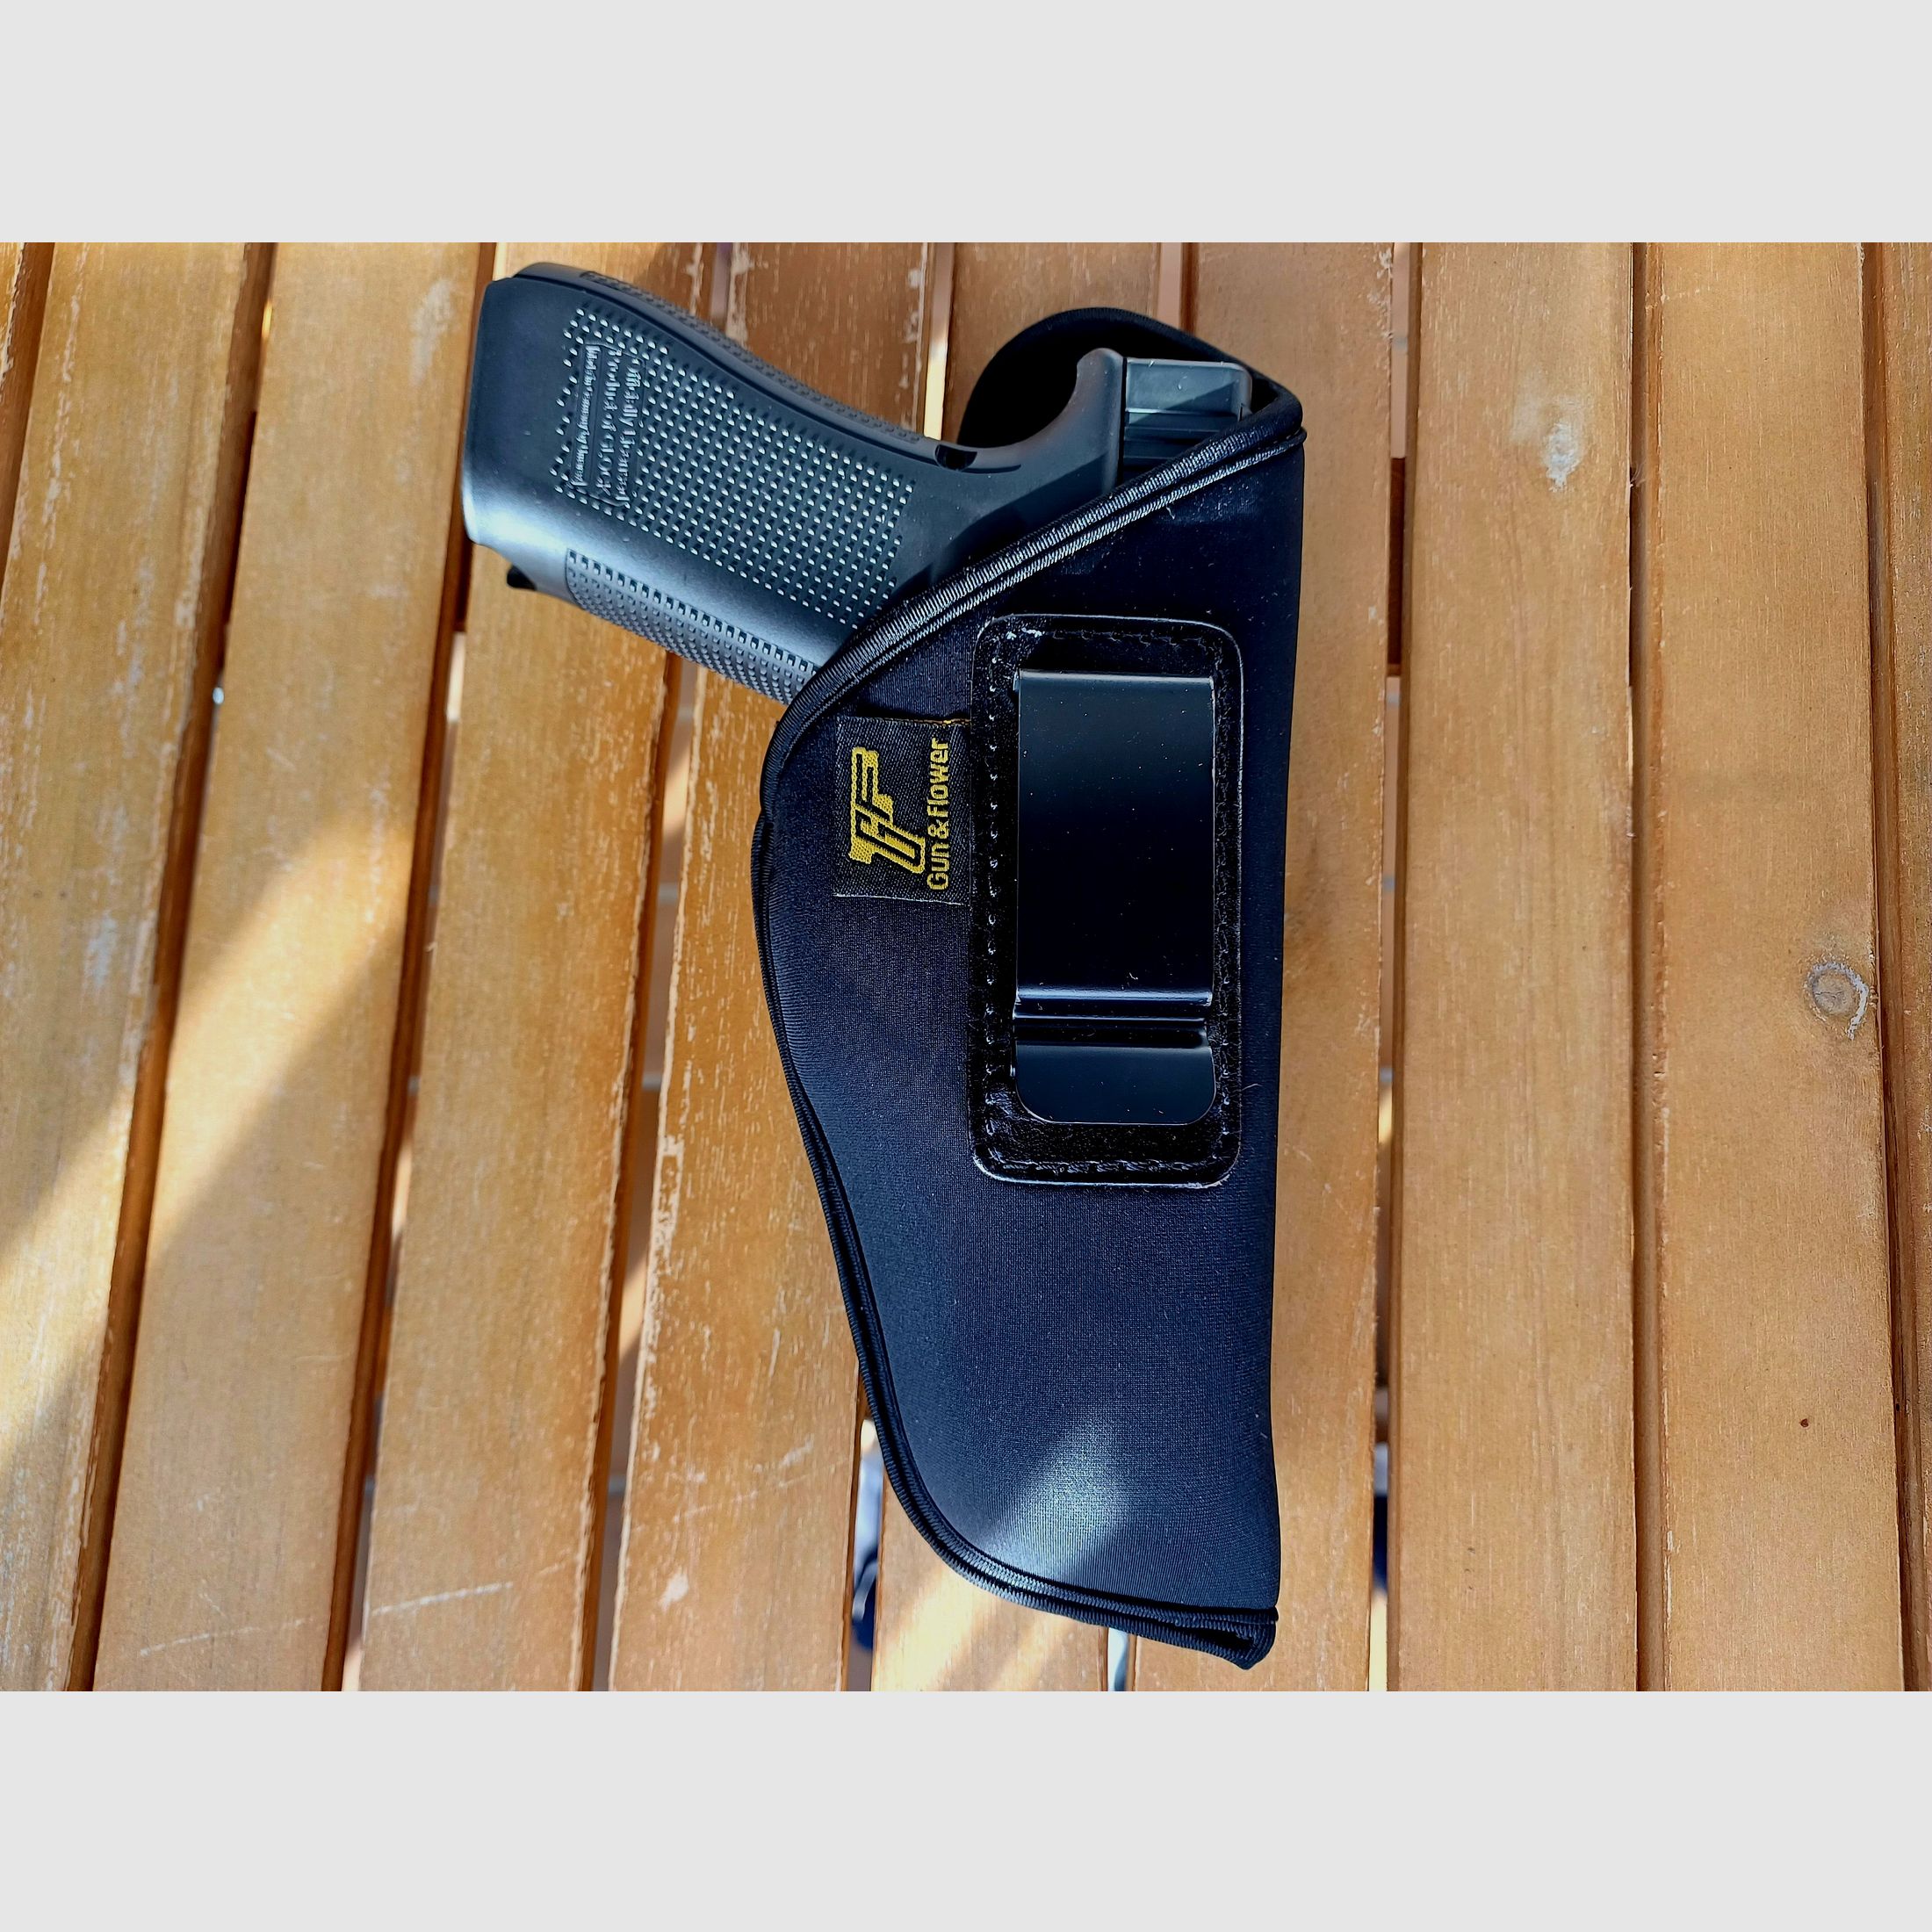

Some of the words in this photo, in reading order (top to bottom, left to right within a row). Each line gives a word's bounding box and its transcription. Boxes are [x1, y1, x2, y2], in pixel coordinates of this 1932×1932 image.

[596, 433, 615, 496] GLOCK
[926, 737, 948, 818] Flower
[927, 819, 949, 840] &
[926, 843, 949, 890] Gun
